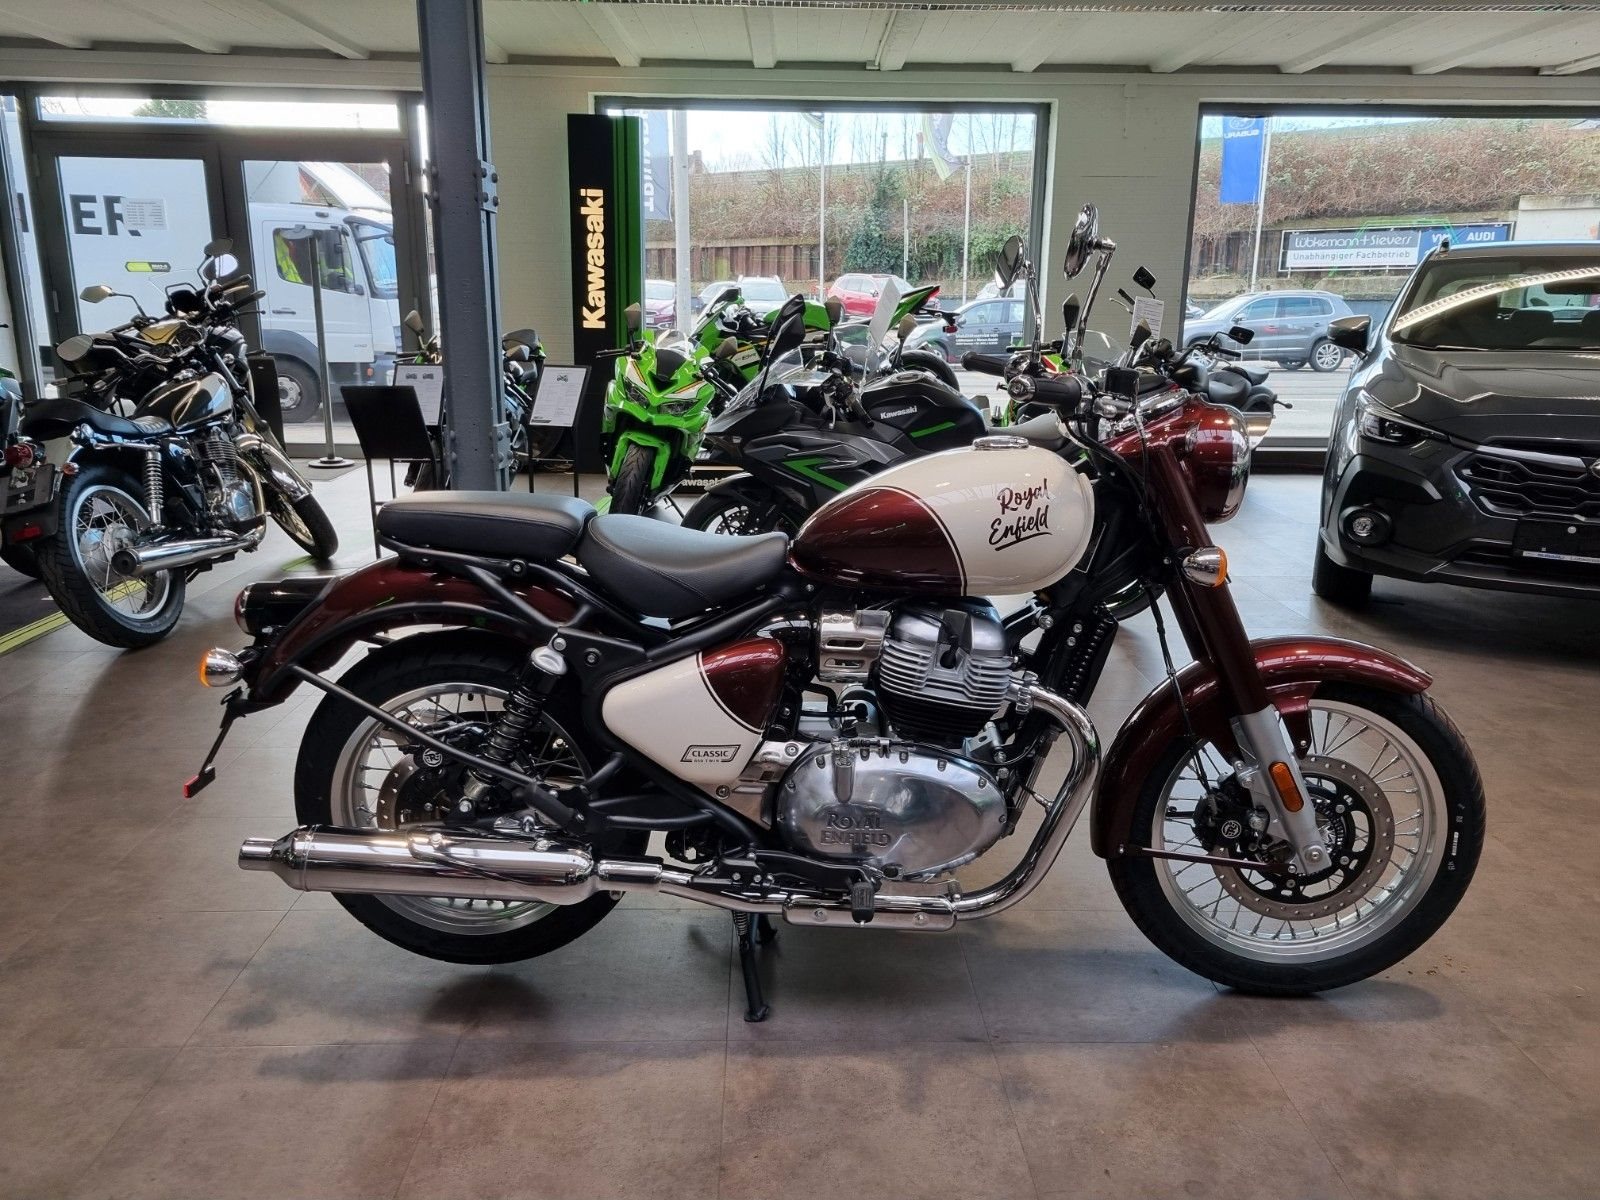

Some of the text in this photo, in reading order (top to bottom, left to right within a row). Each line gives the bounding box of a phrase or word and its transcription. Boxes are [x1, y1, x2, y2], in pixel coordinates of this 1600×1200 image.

[1466, 231, 1496, 241] AUDI
[580, 188, 606, 329] Kawasaki
[1293, 250, 1411, 262] Unabhängiger Fachbetrieb
[880, 405, 918, 419] Kawasaki
[997, 477, 1050, 515] Royal
[988, 504, 1050, 545] Enfield
[692, 750, 728, 758] CLASSIC
[827, 811, 884, 831] ROYAL
[820, 830, 892, 847] ENFIELD
